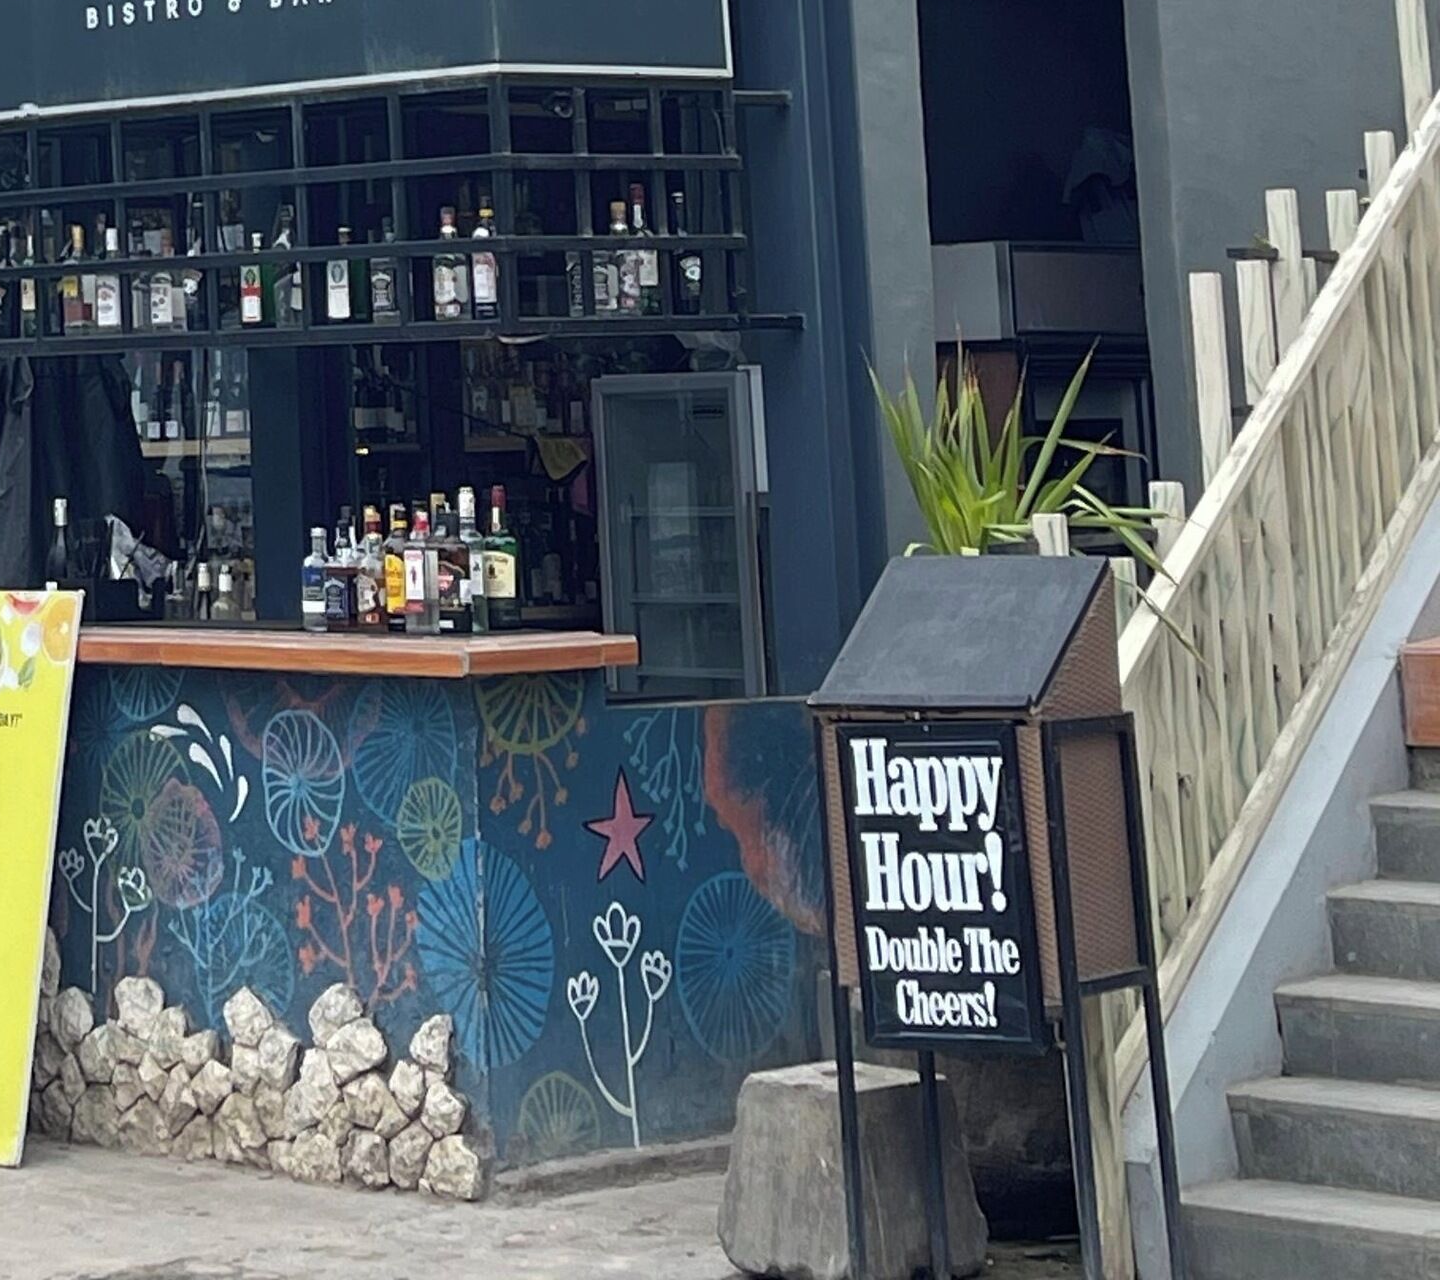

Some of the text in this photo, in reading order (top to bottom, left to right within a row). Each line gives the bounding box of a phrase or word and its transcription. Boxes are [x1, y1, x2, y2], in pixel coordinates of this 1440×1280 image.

[850, 738, 1003, 831] Happy
[860, 831, 1007, 912] Hour!
[864, 925, 1021, 975] Double The
[895, 979, 999, 1028] Cheers!
